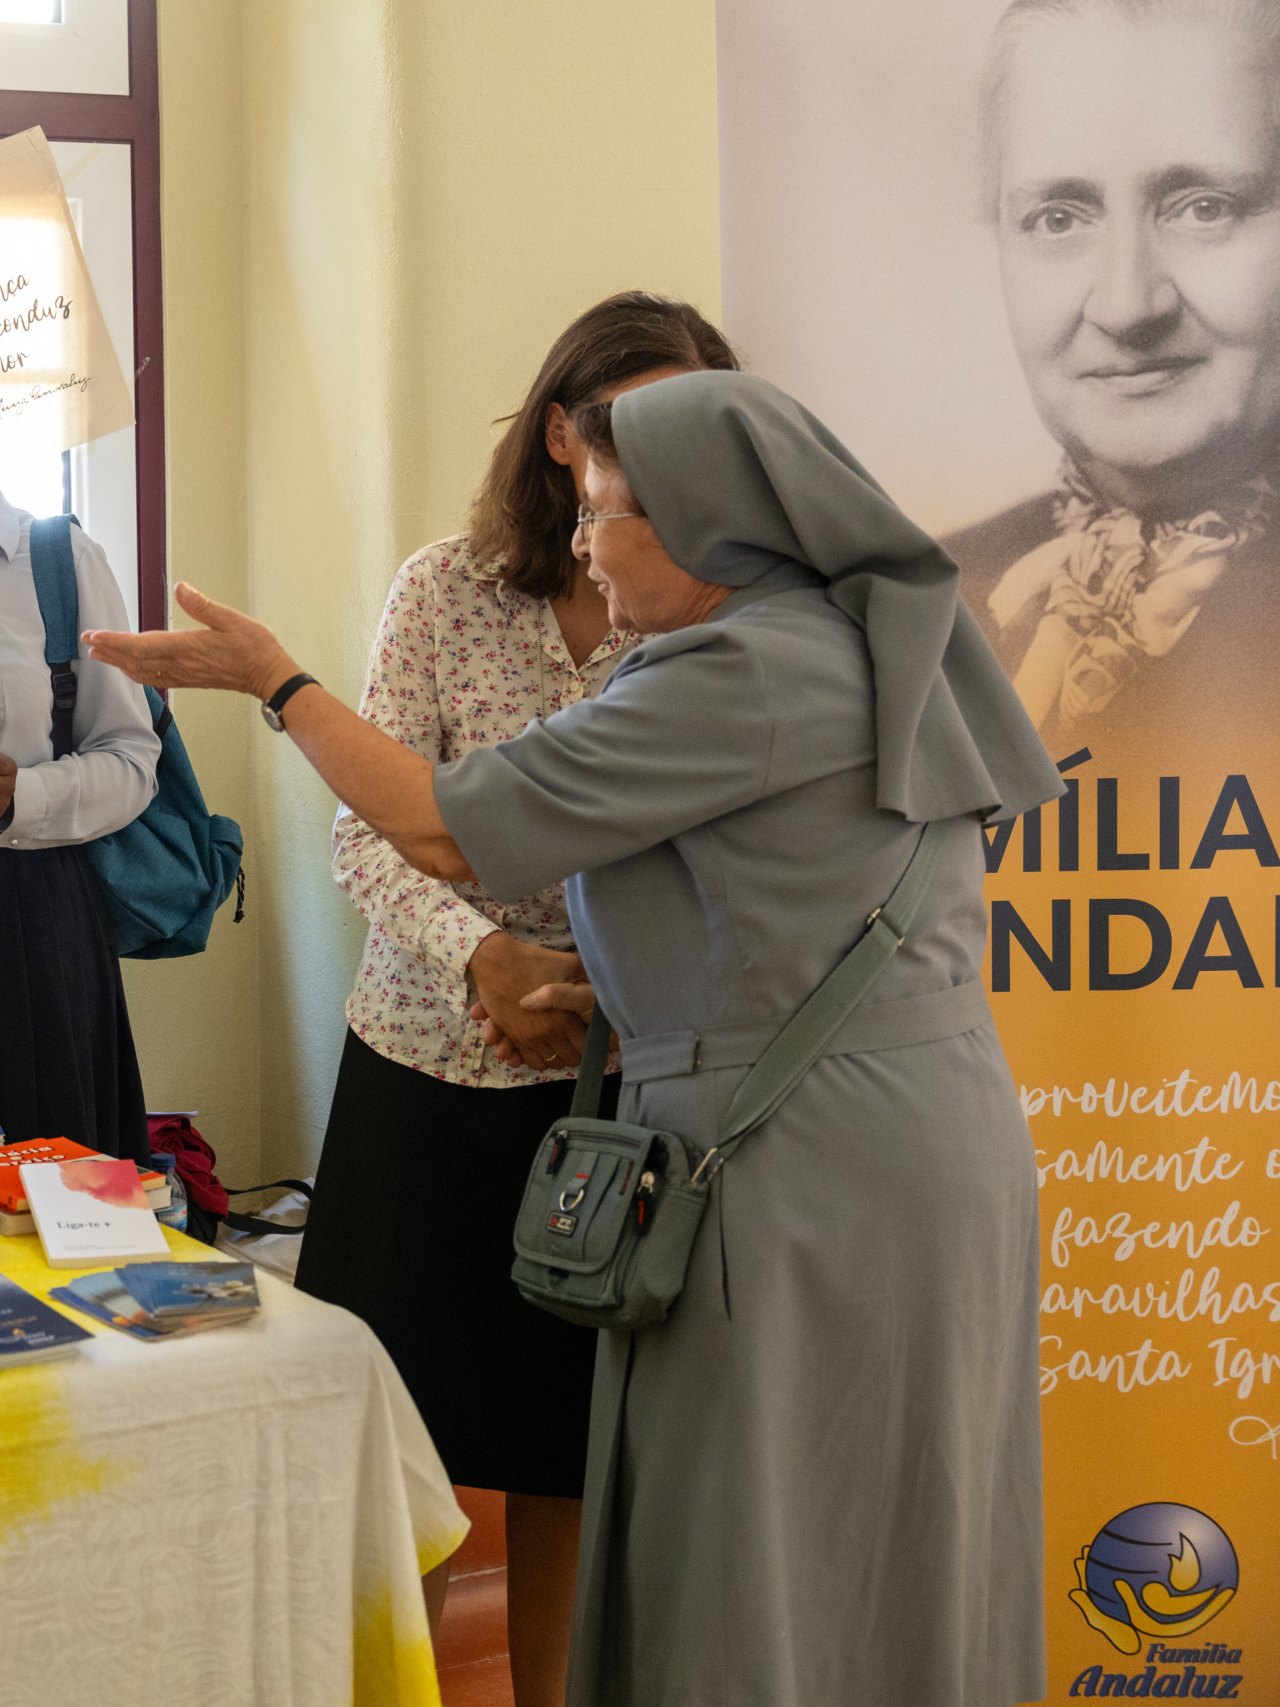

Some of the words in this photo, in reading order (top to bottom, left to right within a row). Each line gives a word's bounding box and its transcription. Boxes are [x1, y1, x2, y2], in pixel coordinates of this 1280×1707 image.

[991, 895, 1280, 992] NDA
[1051, 1200, 1271, 1268] fazendo
[1069, 1665, 1243, 1699] Andaluz
